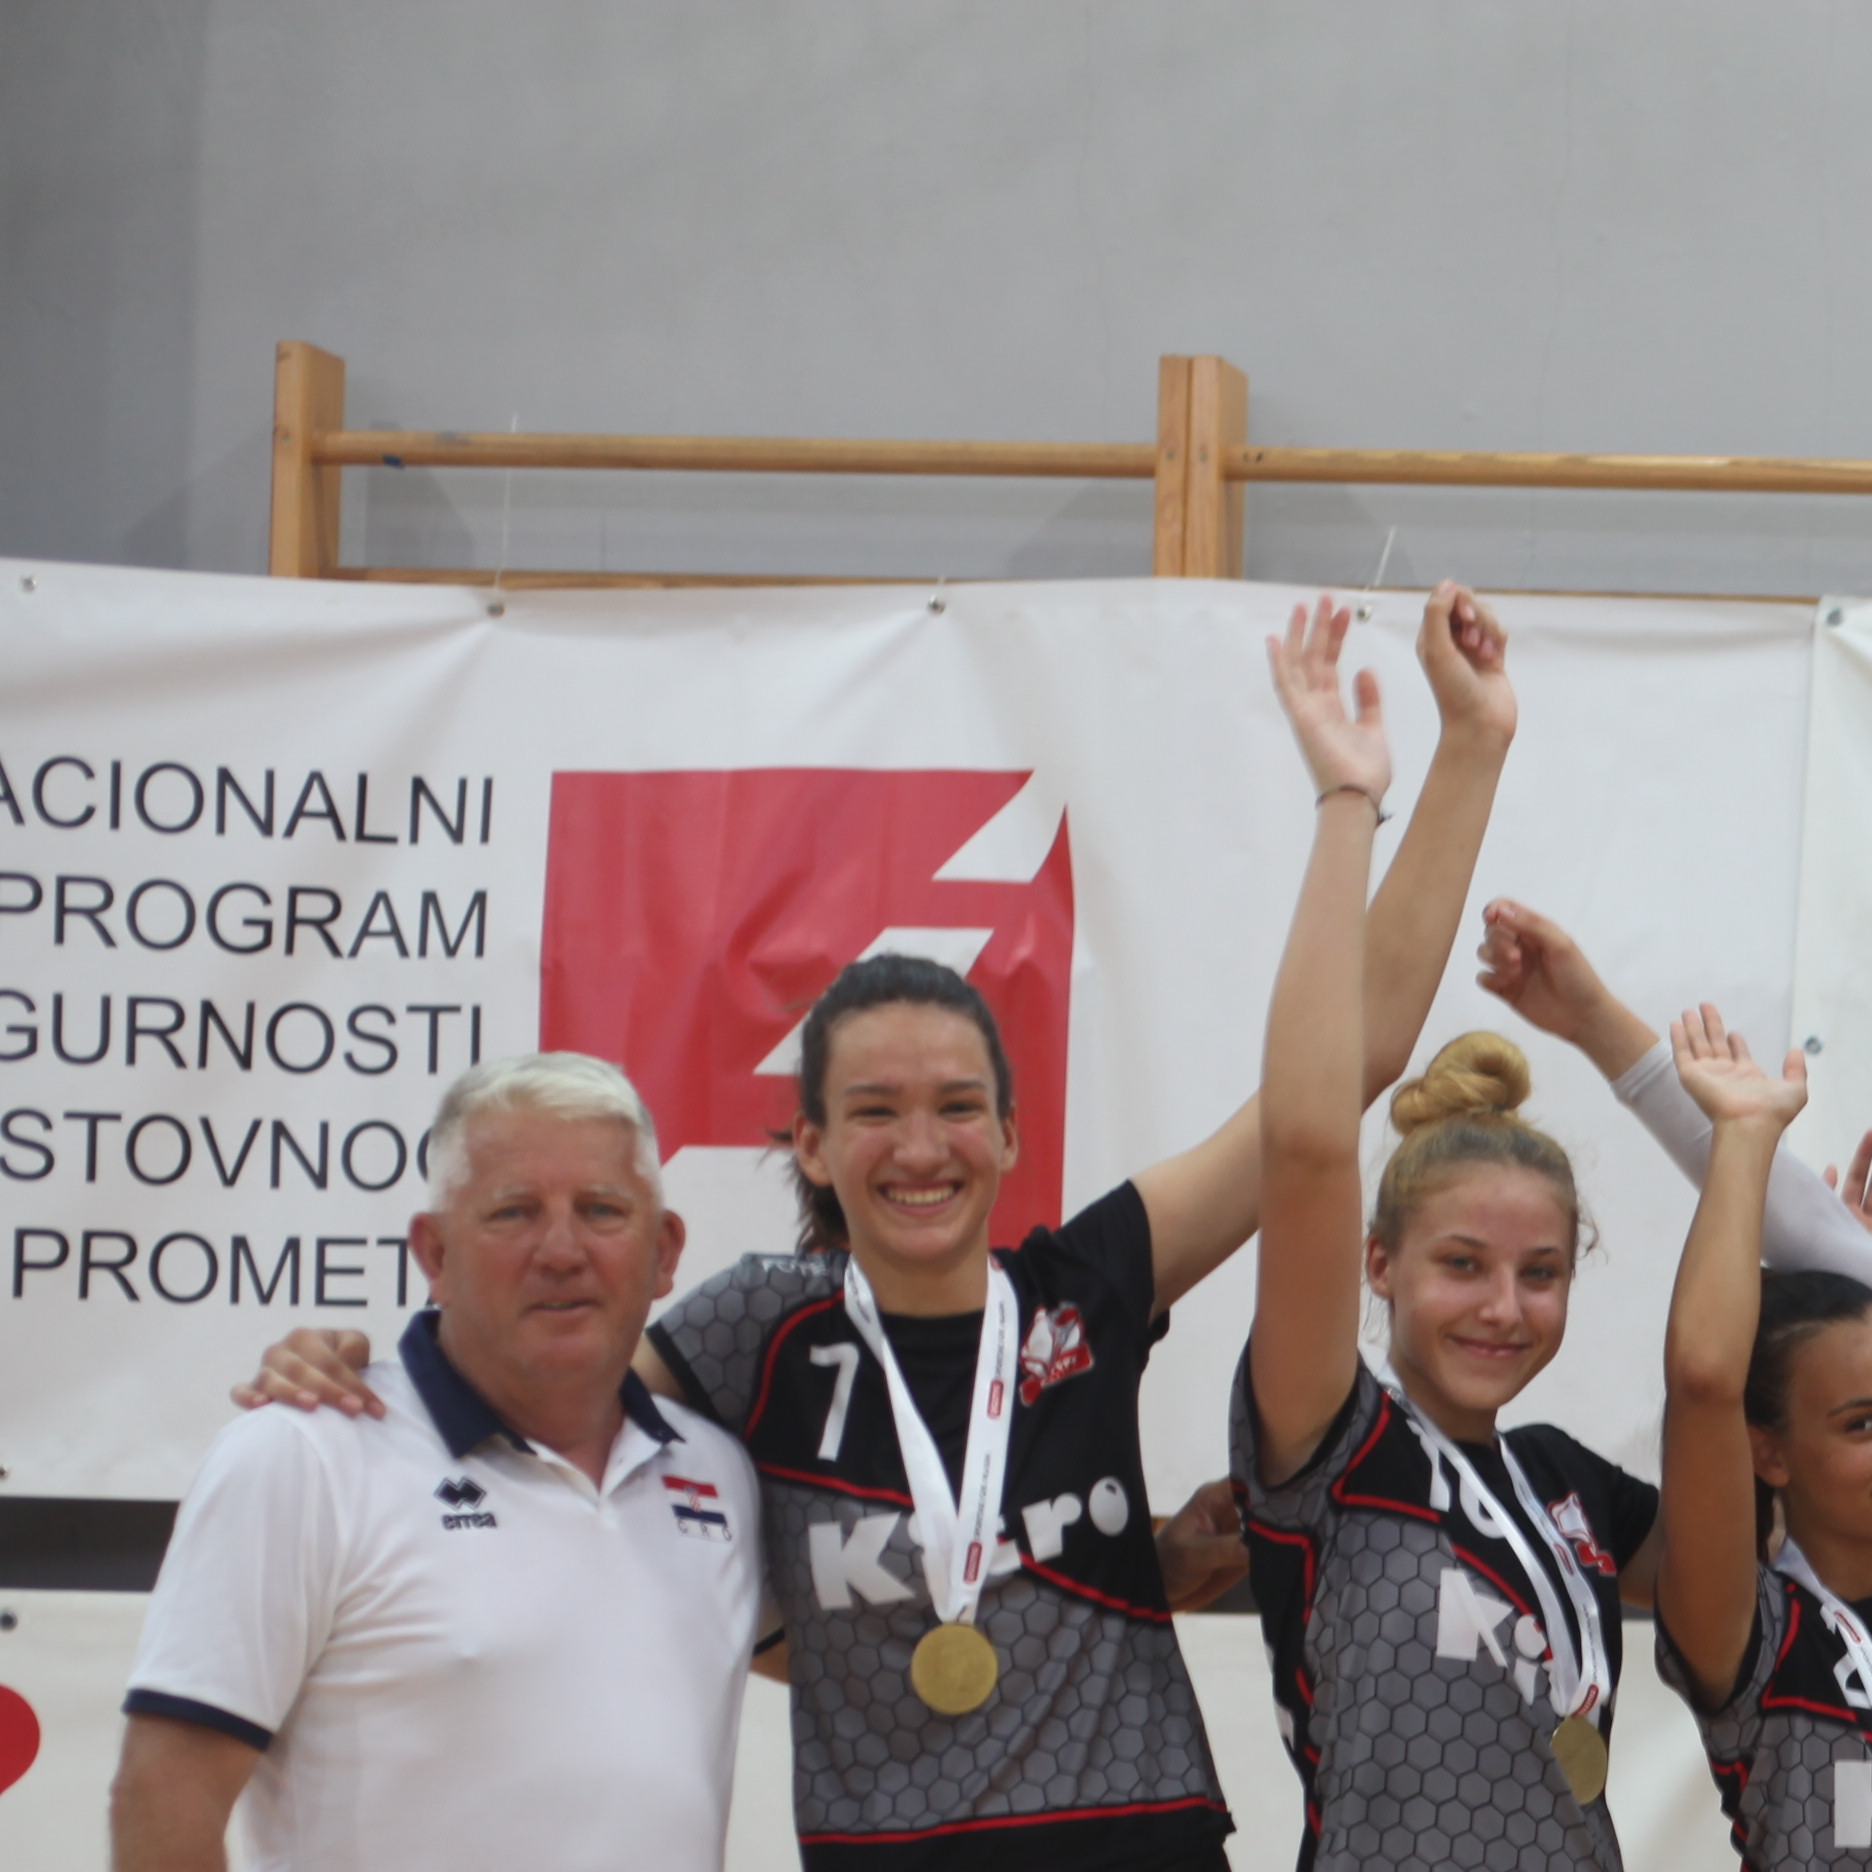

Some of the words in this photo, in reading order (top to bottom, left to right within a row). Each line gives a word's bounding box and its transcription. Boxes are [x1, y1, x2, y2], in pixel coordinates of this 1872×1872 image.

[0, 871, 488, 960] PROGRAM
[0, 1107, 433, 1192] STOVNO
[12, 1226, 440, 1308] PROMET
[809, 1342, 861, 1462] 7
